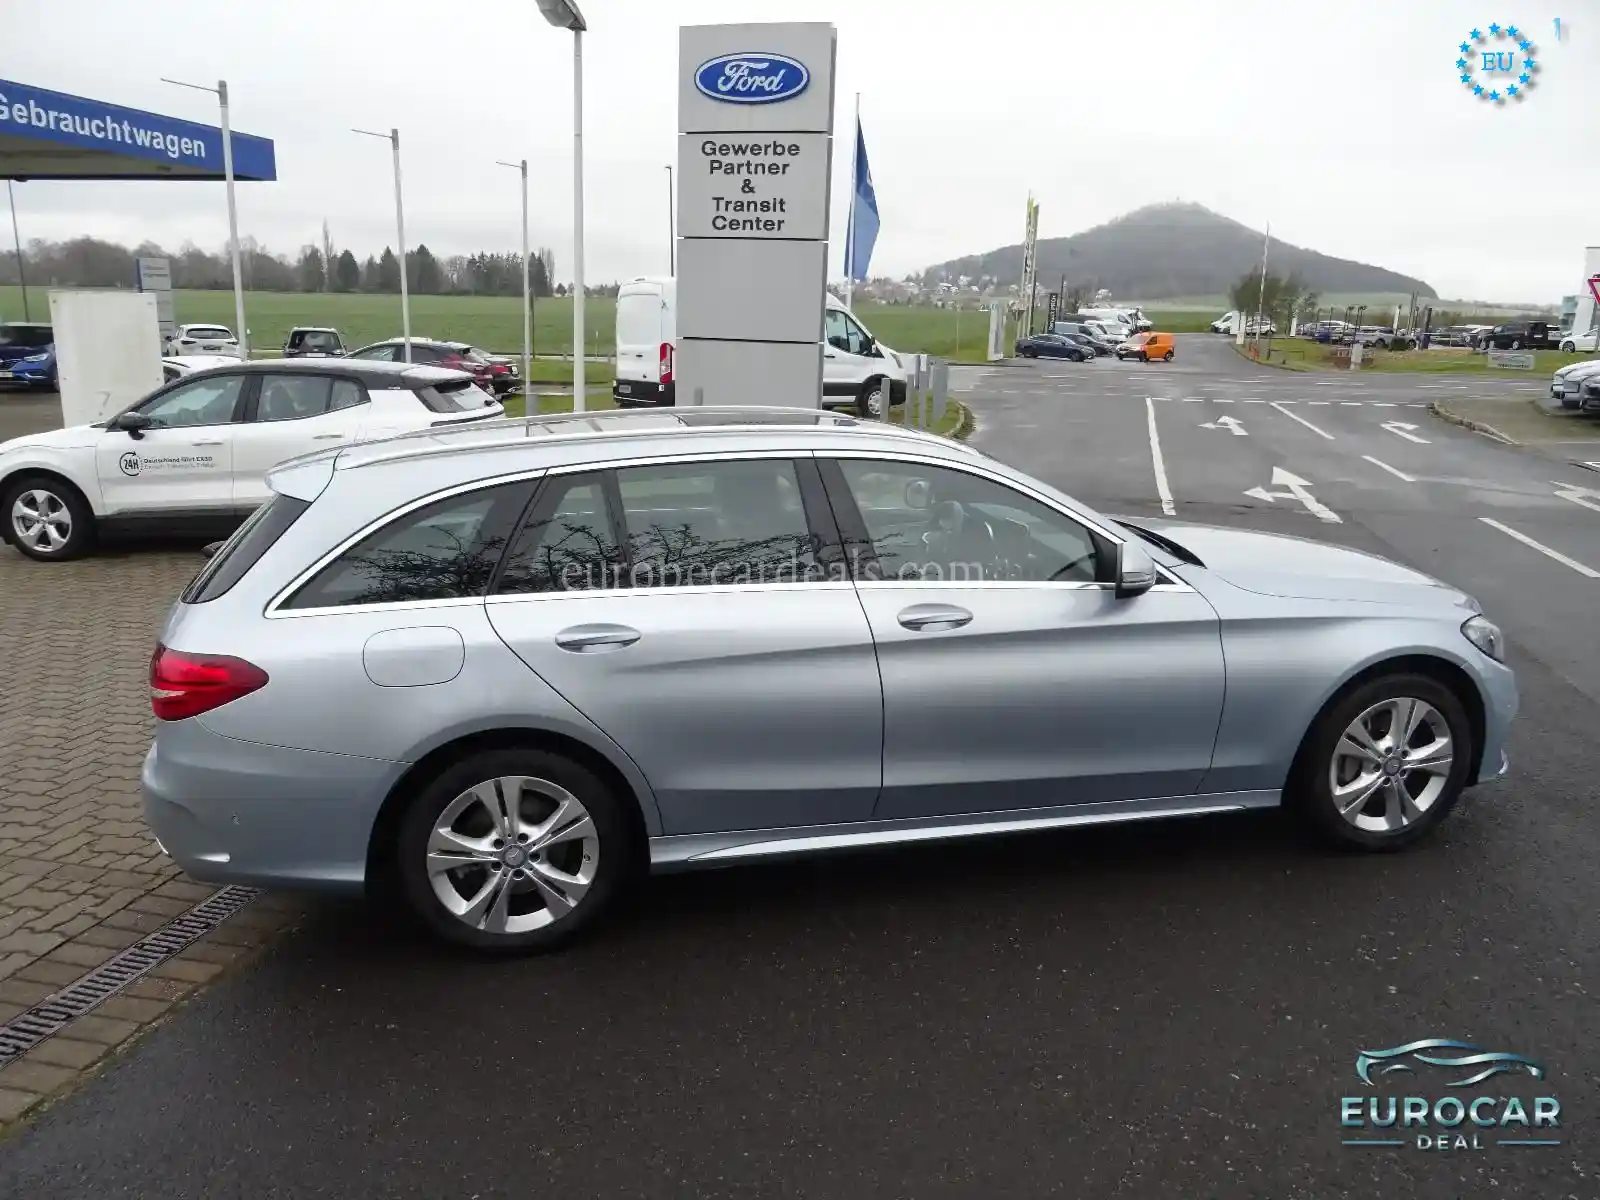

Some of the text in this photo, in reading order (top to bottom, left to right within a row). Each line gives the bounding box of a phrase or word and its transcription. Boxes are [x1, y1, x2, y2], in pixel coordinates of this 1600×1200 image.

[717, 61, 787, 92] Ford
[701, 140, 801, 156] Gewerbe
[709, 160, 790, 175] Partner
[741, 178, 756, 194] &
[711, 196, 786, 213] Transit
[711, 215, 785, 231] Center
[124, 459, 139, 470] 24H
